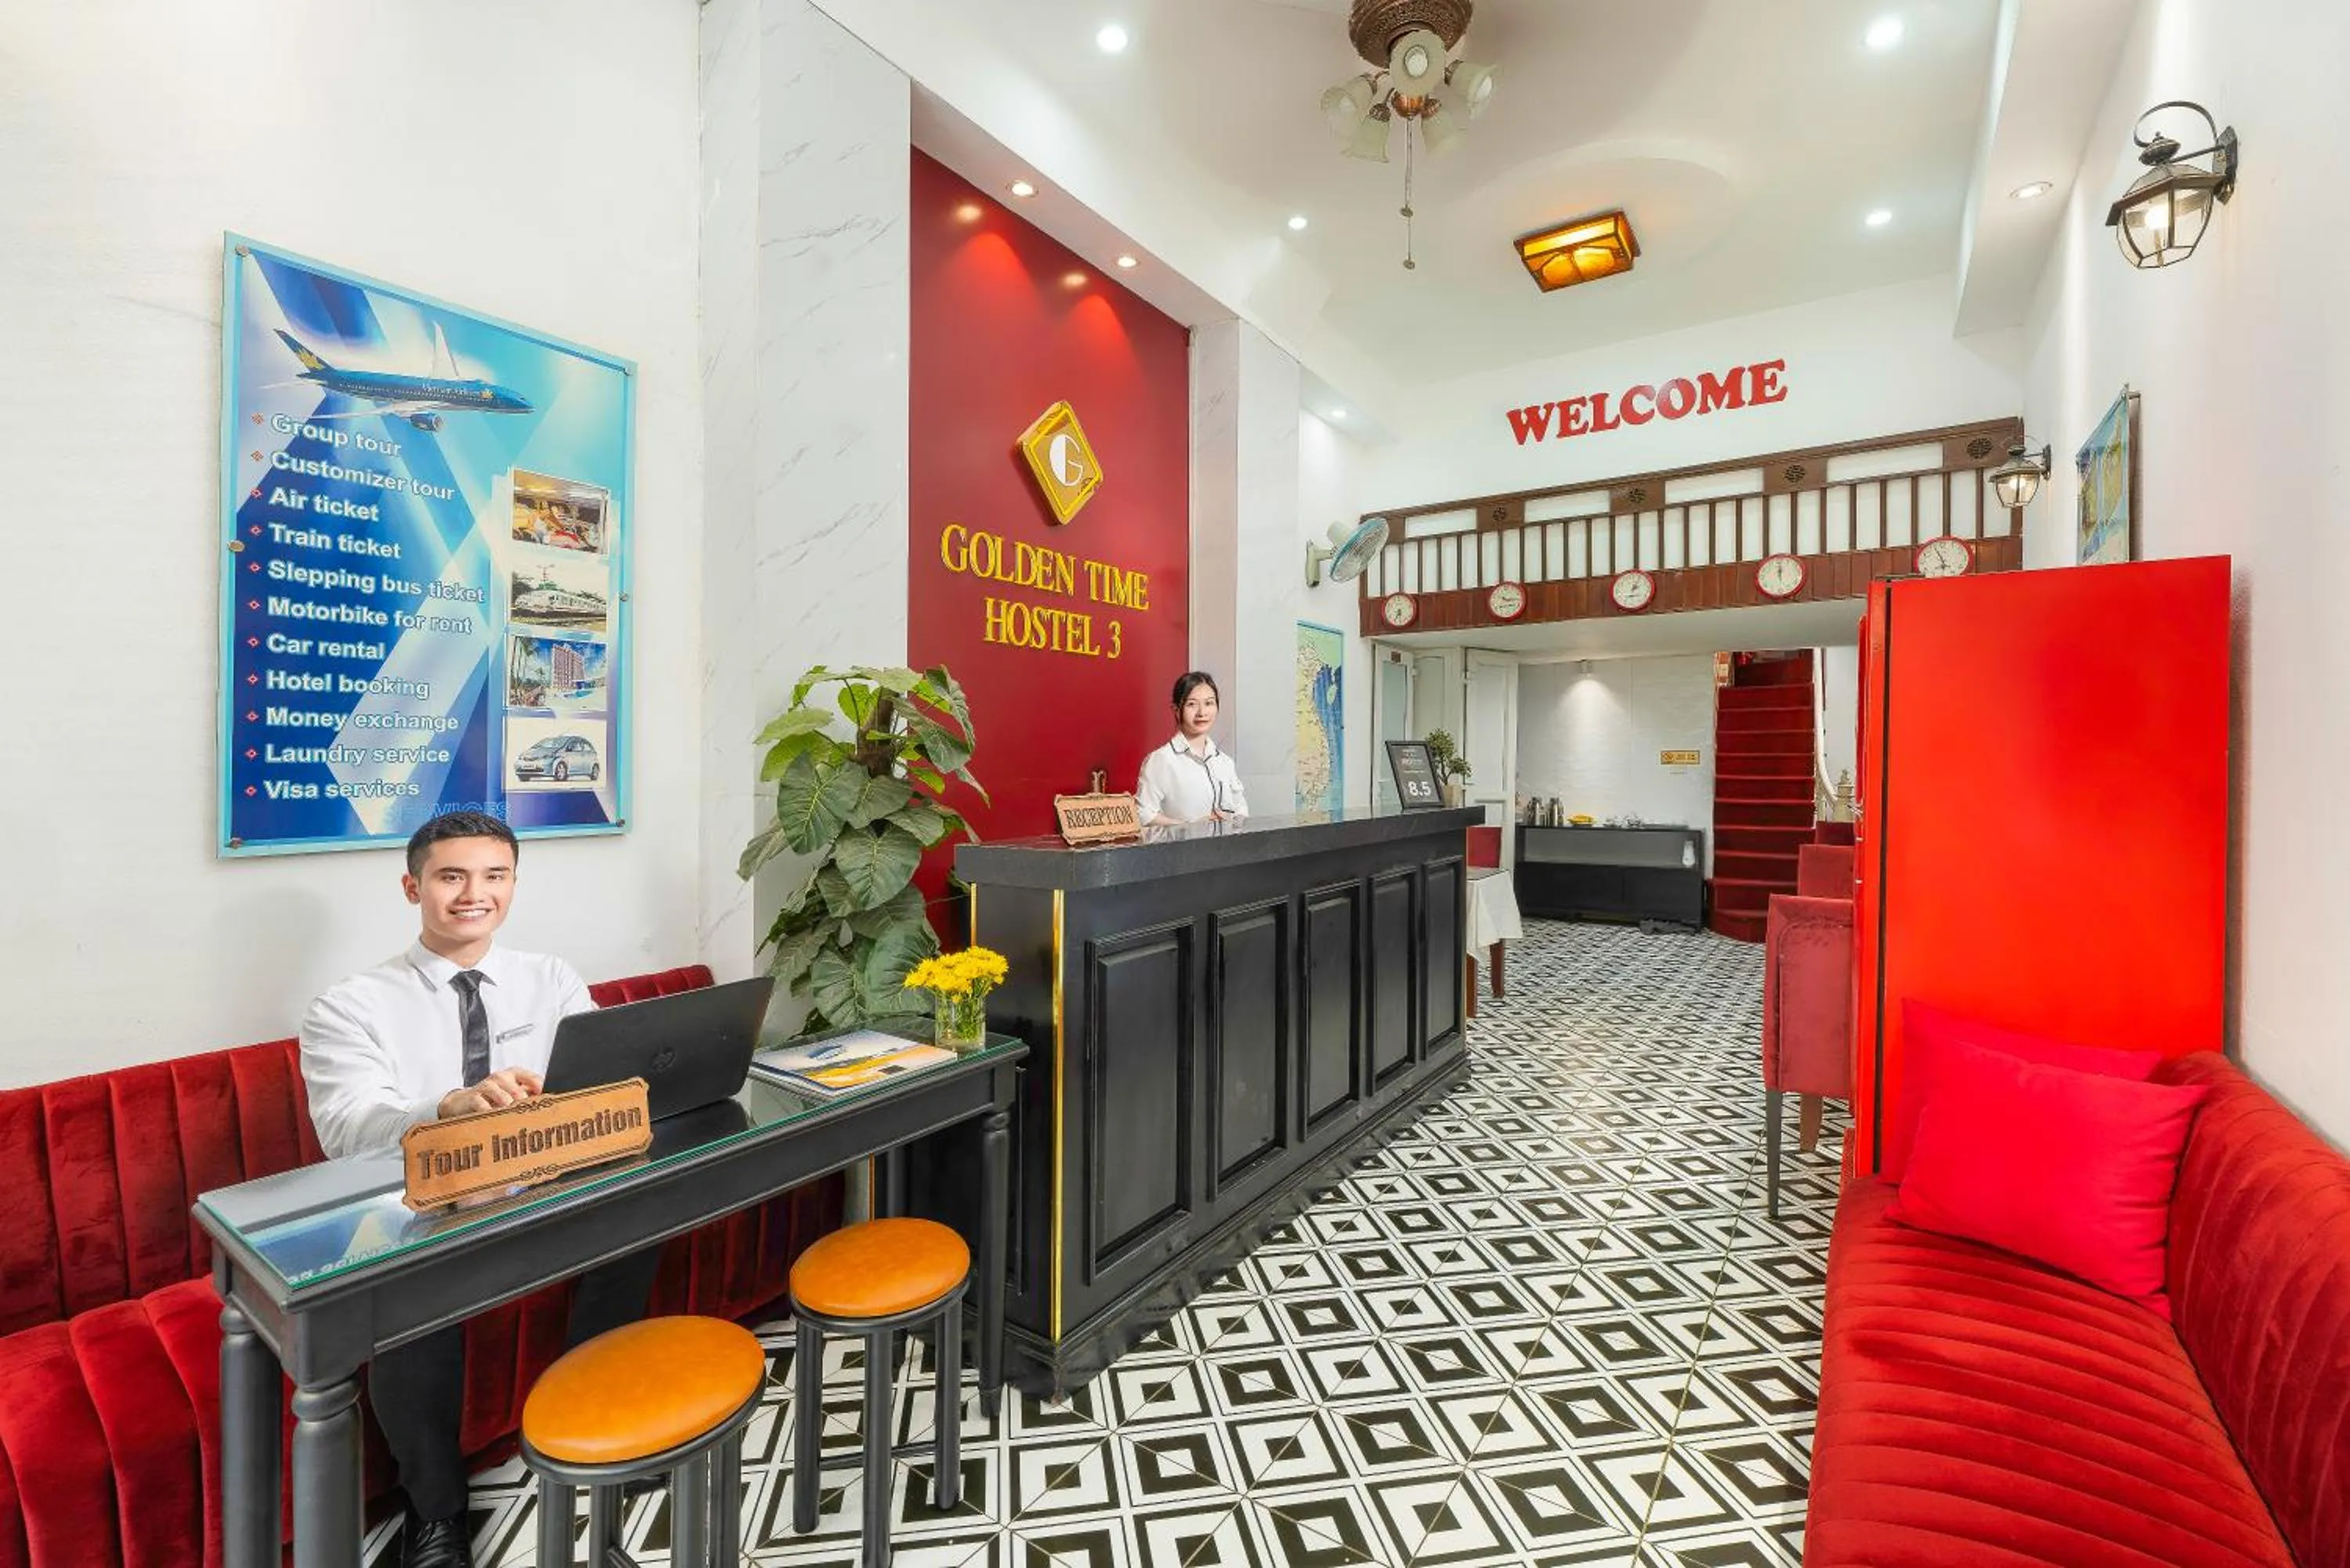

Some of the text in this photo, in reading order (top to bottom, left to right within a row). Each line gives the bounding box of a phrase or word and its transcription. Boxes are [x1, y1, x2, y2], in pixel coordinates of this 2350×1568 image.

[1506, 359, 1788, 446] WELCOME
[271, 414, 402, 457] Group tour
[271, 451, 455, 500] Customizer tour
[269, 486, 379, 522] Air ticket
[269, 524, 401, 558] Train ticket
[267, 560, 485, 604] Slepping bus ticket
[941, 524, 1149, 610] GOLDEN TIME
[267, 597, 472, 634] Motorbike for rent
[983, 598, 1122, 659] HOSTEL 3
[266, 632, 385, 659] Car rental
[266, 669, 430, 699] Hotel booking
[266, 707, 459, 734] Money exchange
[265, 744, 450, 765] Laundry service
[263, 780, 420, 799] Visa services
[1408, 781, 1431, 797] 8.5
[1064, 804, 1133, 829] RECEPTION
[416, 1106, 642, 1180] Tour Information
